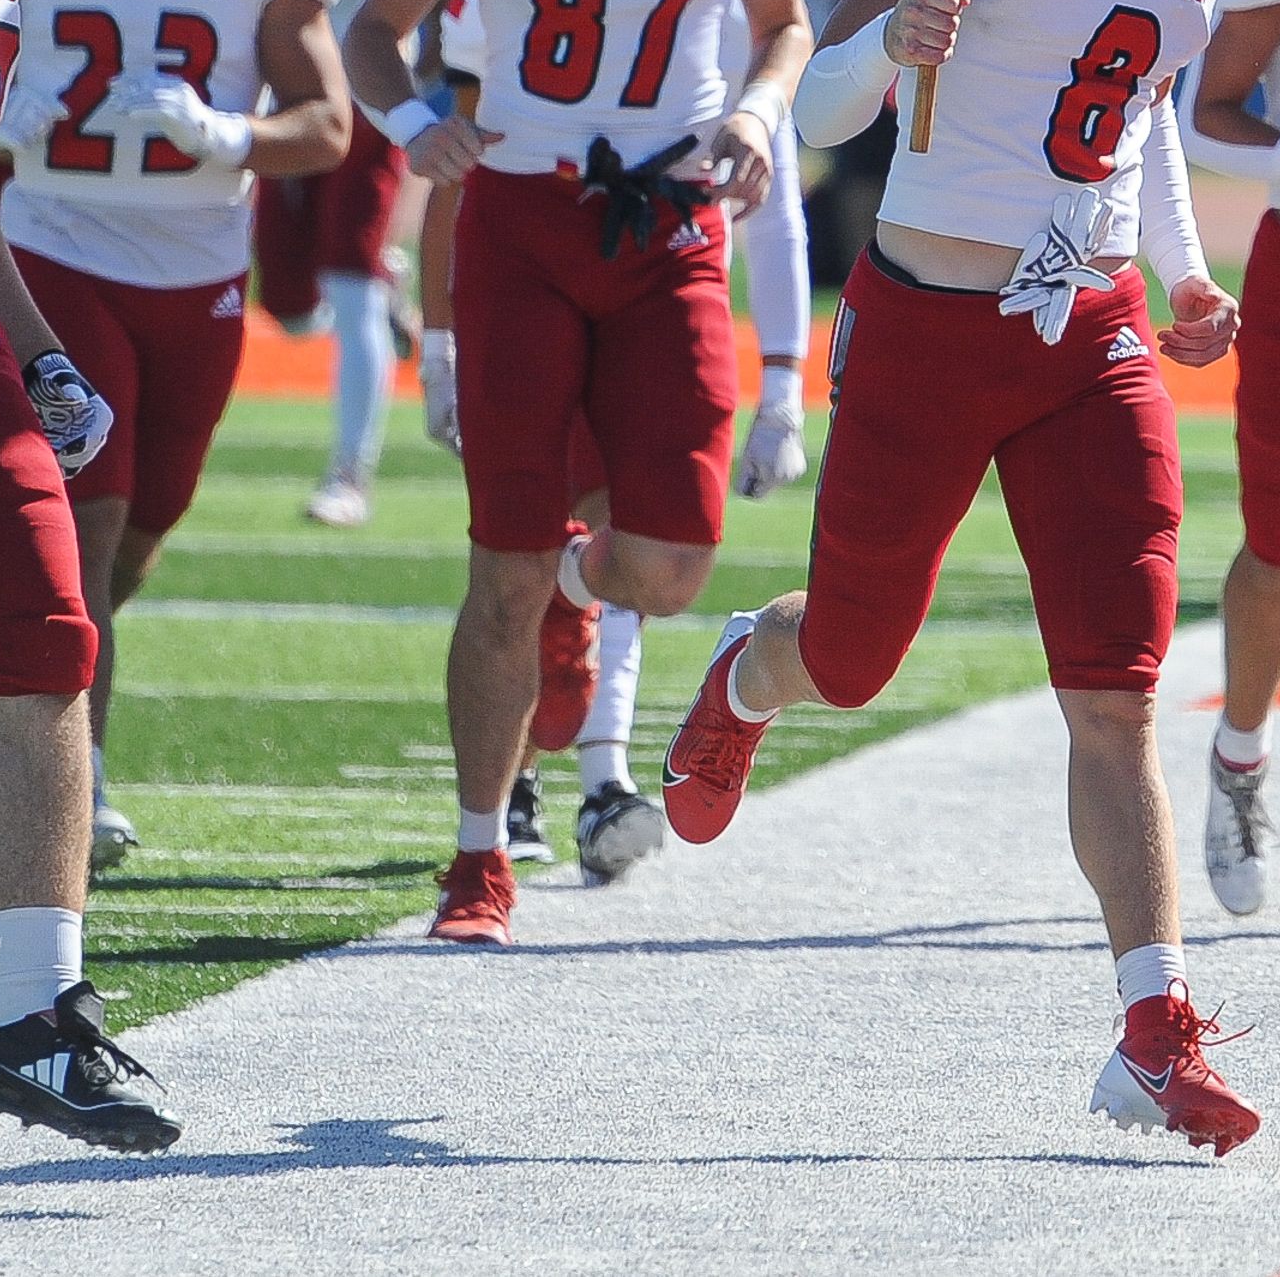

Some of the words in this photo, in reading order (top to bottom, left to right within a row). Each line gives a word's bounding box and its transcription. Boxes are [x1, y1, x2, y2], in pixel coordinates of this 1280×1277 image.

[46, 8, 218, 175] 23
[1043, 4, 1162, 184] 8
[1107, 343, 1150, 361] adidas
